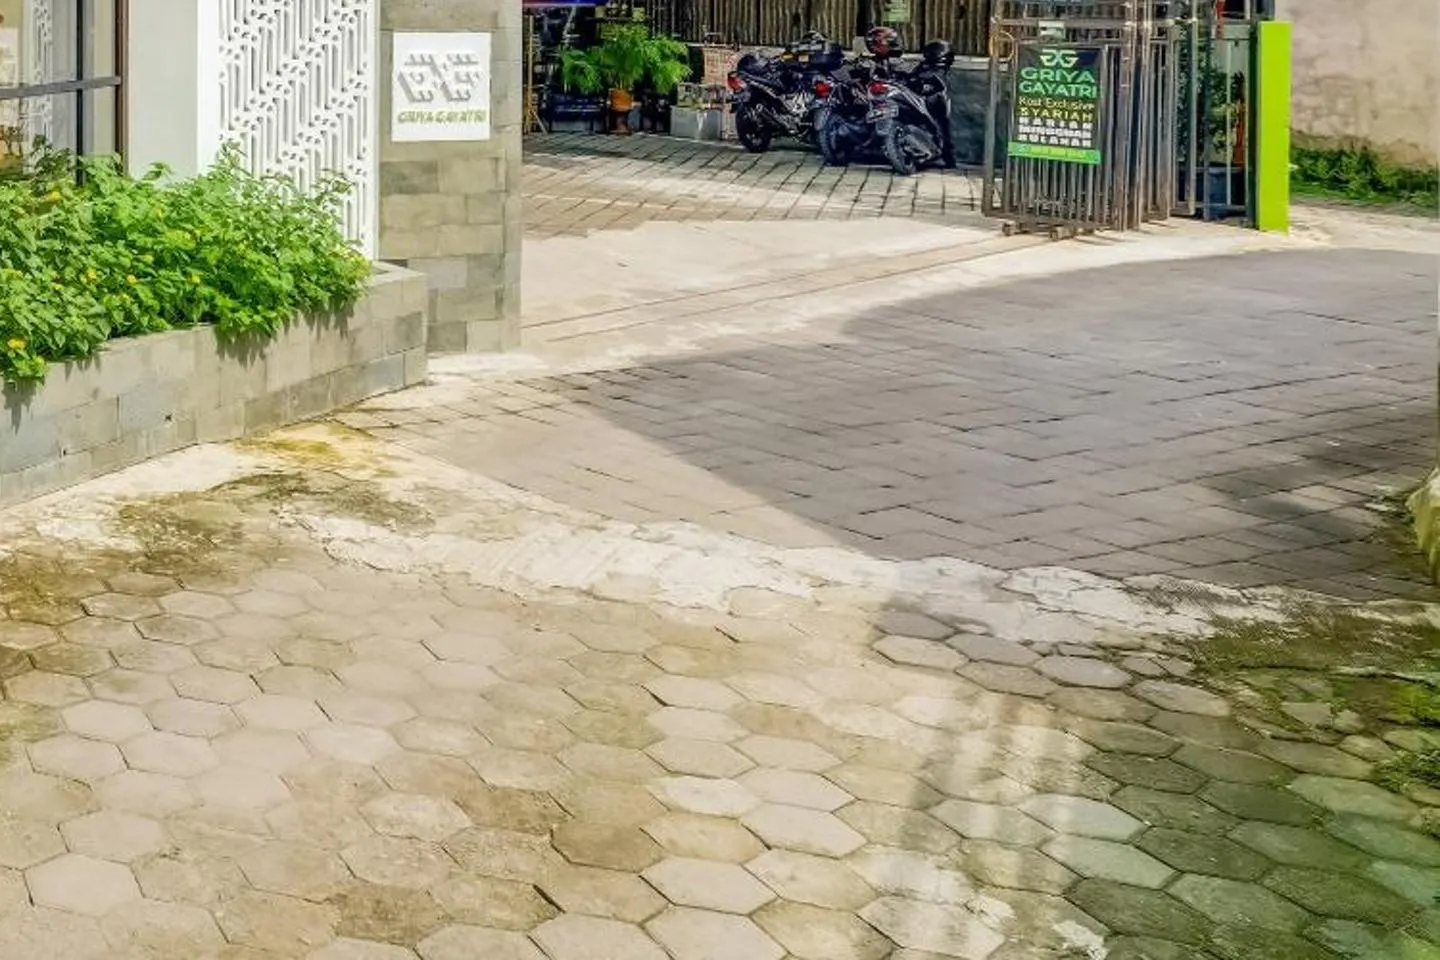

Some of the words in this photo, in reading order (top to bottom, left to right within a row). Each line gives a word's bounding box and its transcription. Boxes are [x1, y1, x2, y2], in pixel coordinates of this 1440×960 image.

[1020, 67, 1096, 83] GRIYA
[1019, 80, 1097, 98] GAYATRI
[1020, 107, 1092, 122] SYARIAH
